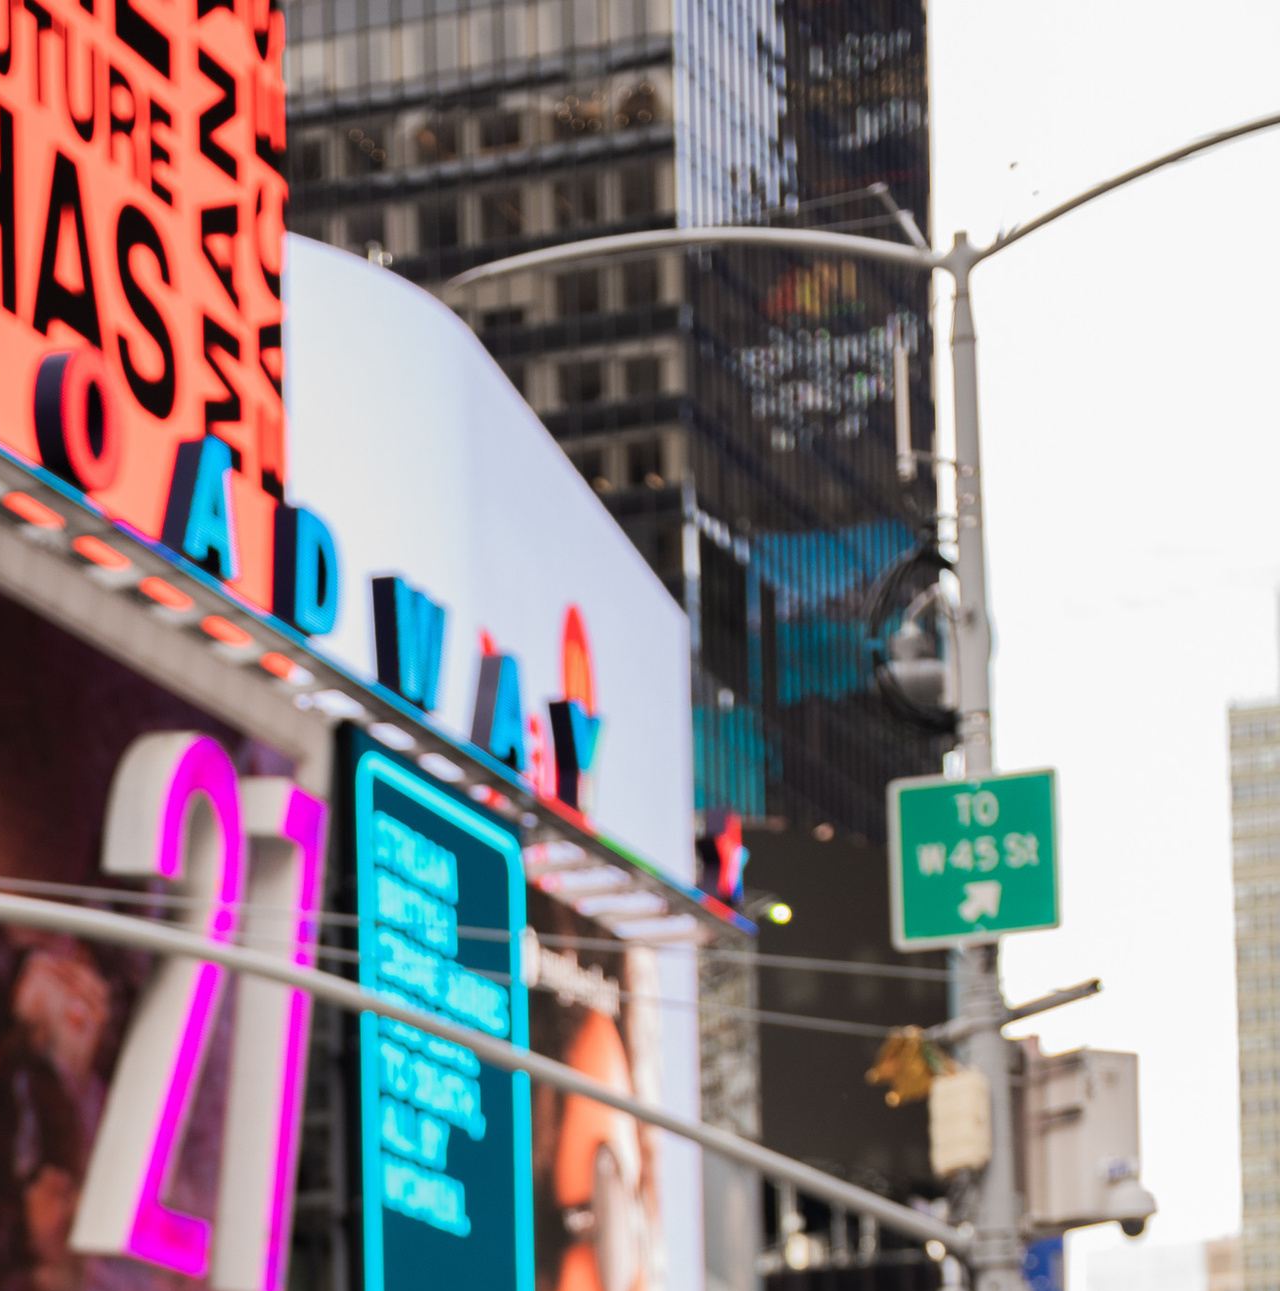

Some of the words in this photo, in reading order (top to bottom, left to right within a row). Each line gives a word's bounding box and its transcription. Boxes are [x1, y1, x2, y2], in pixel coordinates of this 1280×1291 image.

[952, 789, 1000, 828] TO
[916, 841, 947, 876] W
[949, 834, 1000, 873] 45
[1003, 830, 1040, 869] St
